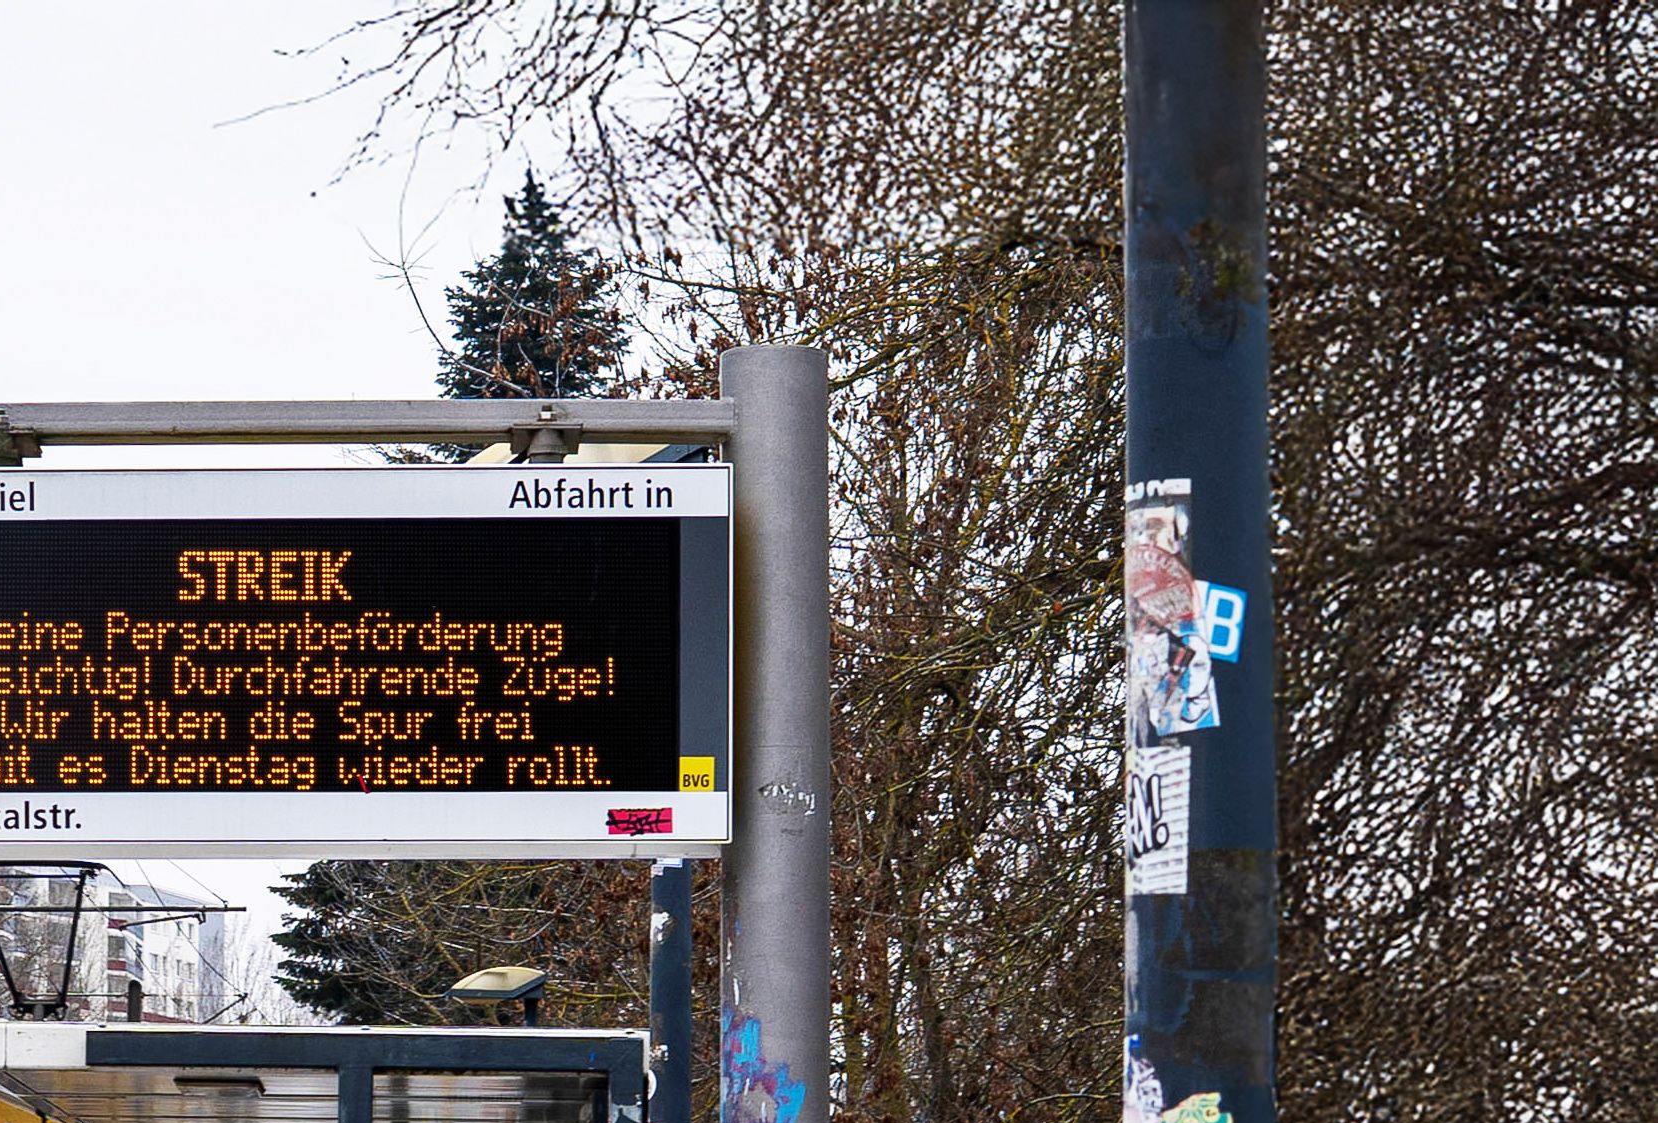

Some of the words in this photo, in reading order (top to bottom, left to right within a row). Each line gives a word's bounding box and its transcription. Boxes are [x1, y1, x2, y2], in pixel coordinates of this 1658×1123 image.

[508, 478, 634, 510] Abfahrt
[646, 478, 673, 509] in
[178, 550, 352, 601] STREIK
[107, 611, 563, 656] Personenbeförderung
[173, 655, 479, 696] Durchfahrende
[503, 656, 614, 701] Züge!
[0, 700, 70, 740] Wir
[93, 700, 226, 740] halten
[250, 700, 315, 740] die
[338, 701, 433, 744] Spur
[457, 701, 535, 740] frei
[59, 755, 107, 784] es
[131, 745, 315, 791] Dienstag
[338, 746, 484, 785] wieder
[508, 746, 612, 785] rollt.
[682, 773, 710, 788] BVG
